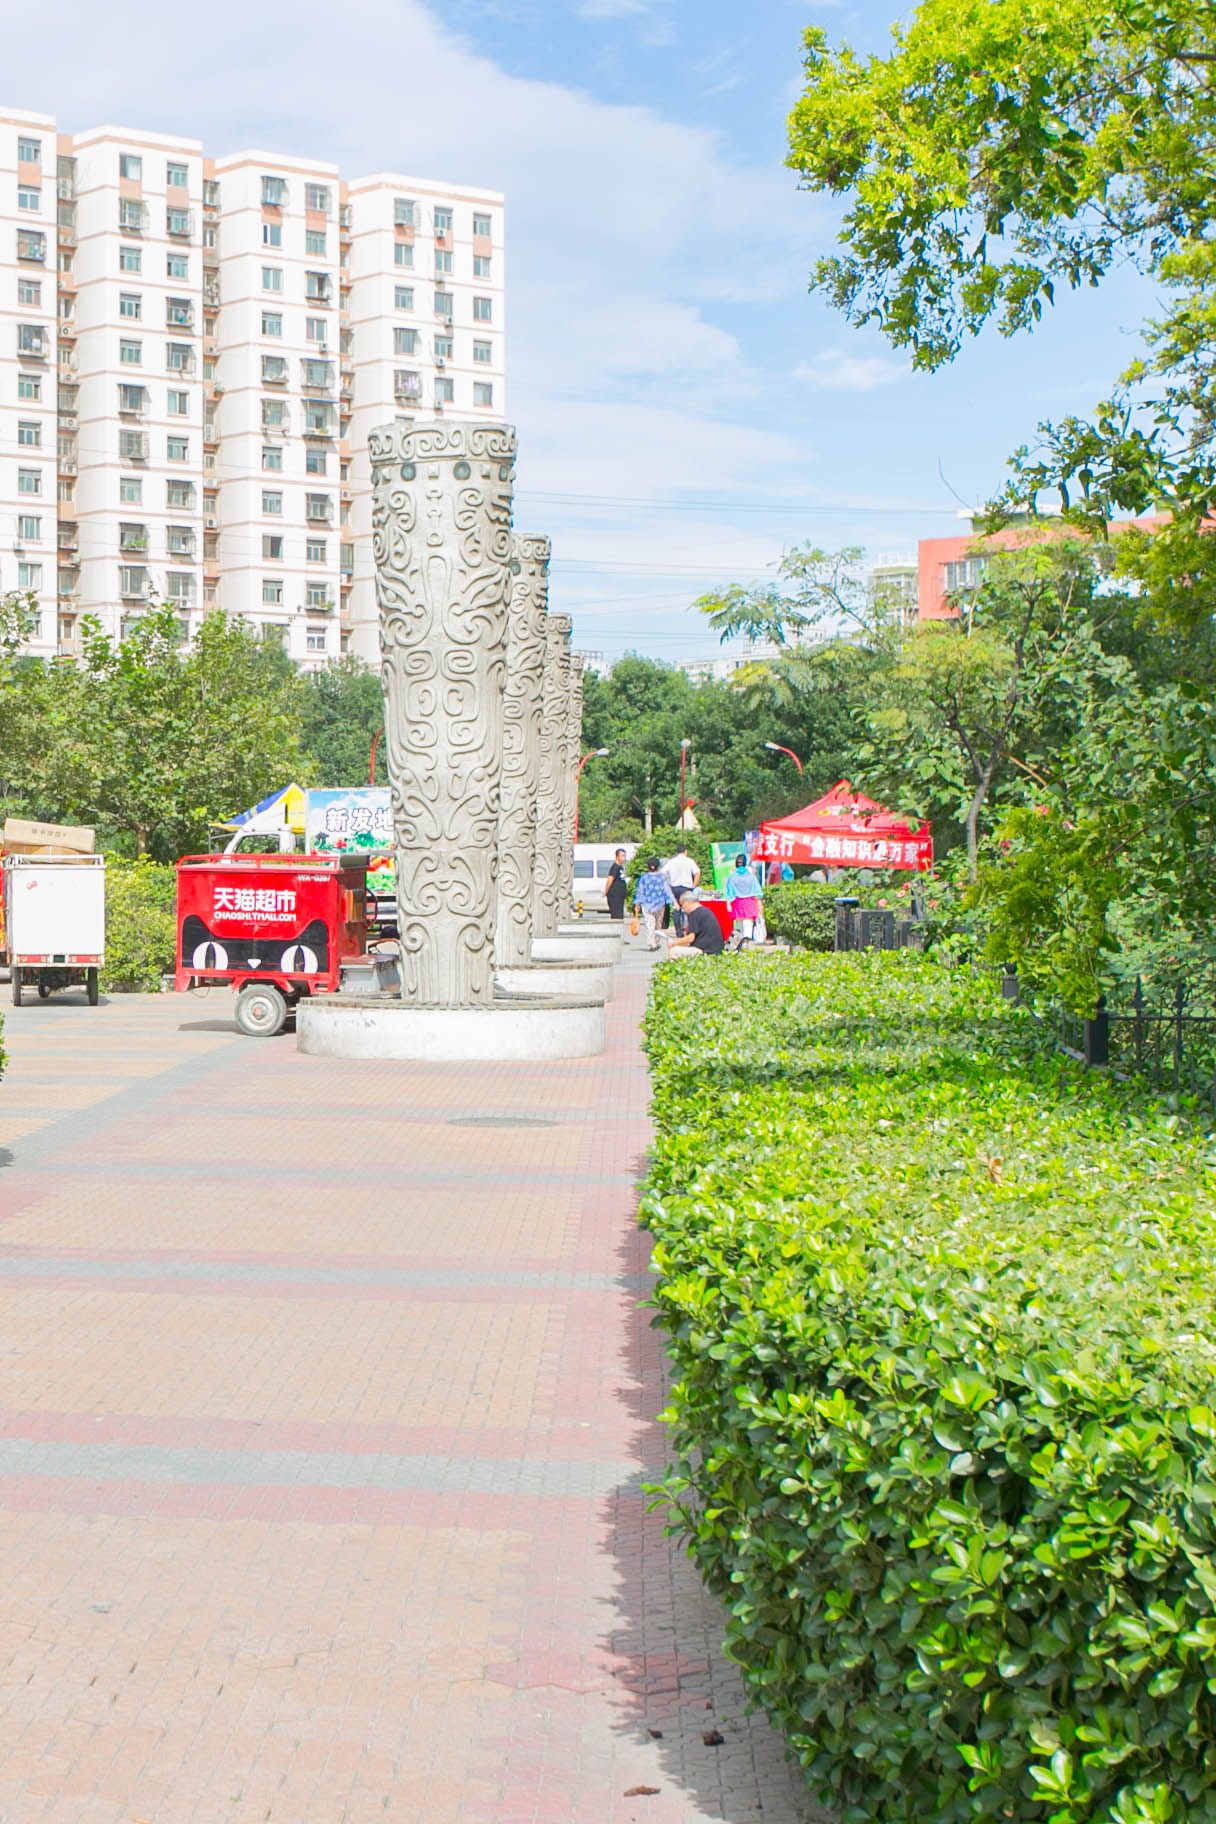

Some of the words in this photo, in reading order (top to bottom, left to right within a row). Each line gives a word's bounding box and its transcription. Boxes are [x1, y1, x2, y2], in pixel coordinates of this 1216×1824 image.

[325, 807, 395, 832] 新发地
[213, 887, 297, 912] 天猫超市
